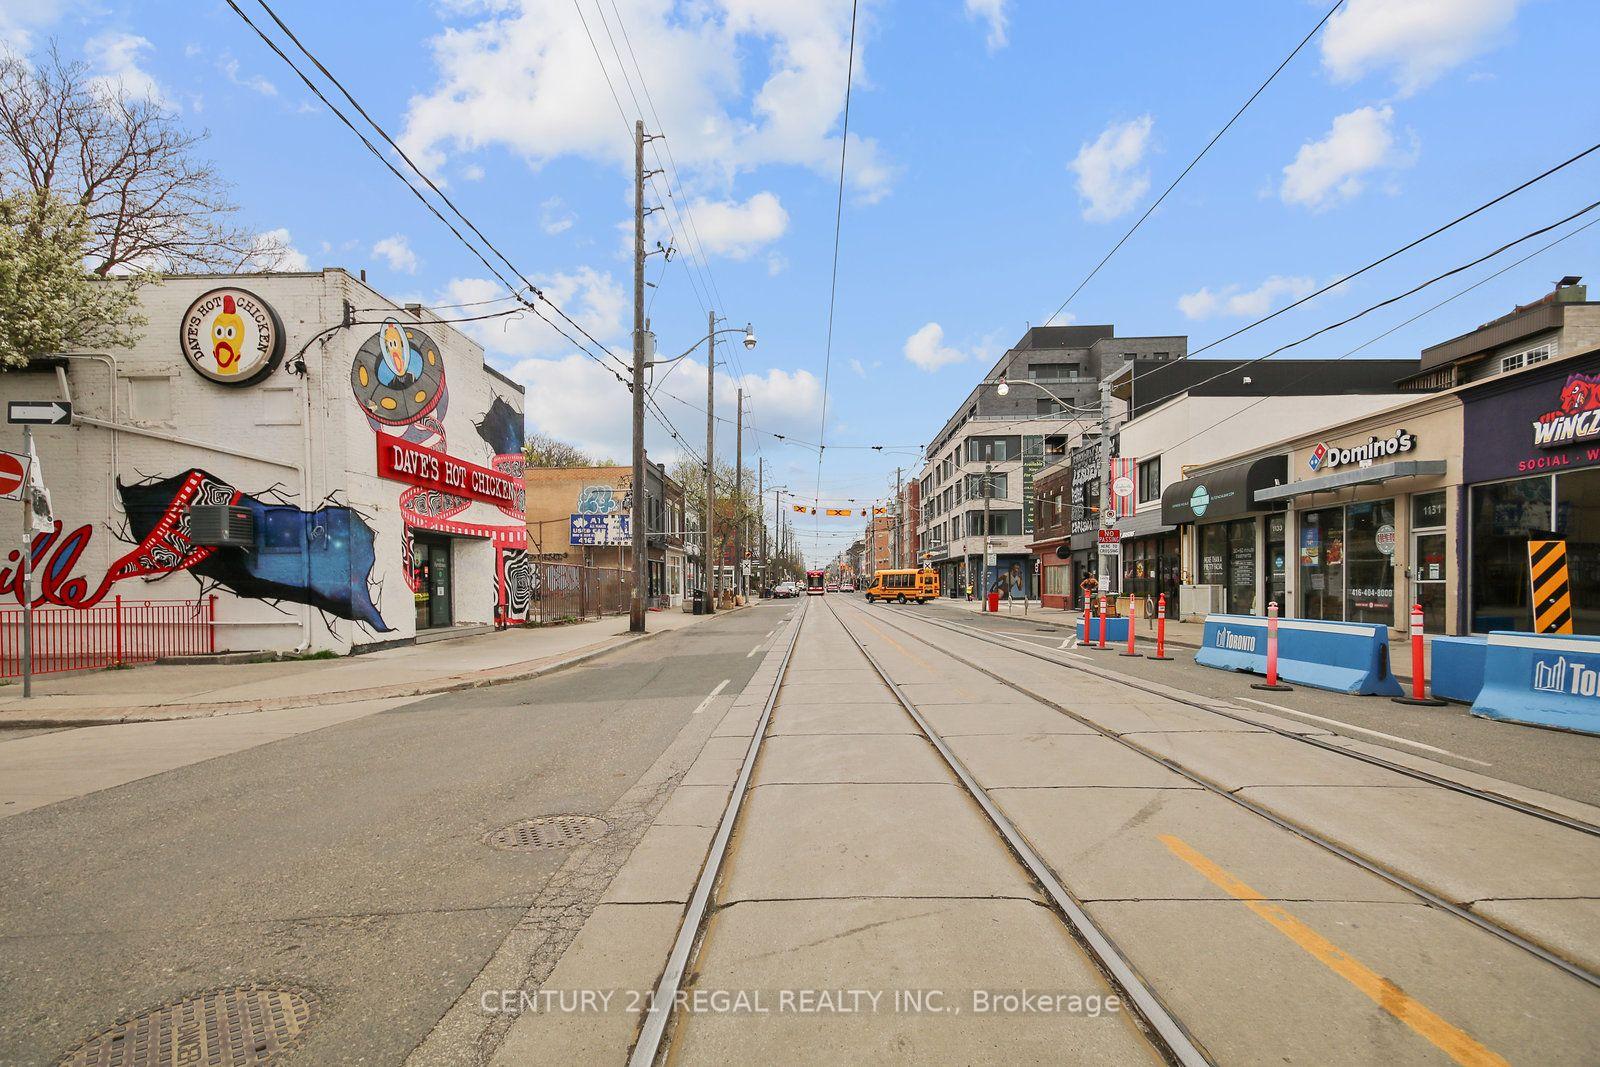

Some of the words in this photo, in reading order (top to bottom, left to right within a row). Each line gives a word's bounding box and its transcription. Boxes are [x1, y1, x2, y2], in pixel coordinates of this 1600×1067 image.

[188, 316, 205, 361] DAVE'S
[197, 296, 222, 317] HOT
[236, 297, 270, 353] CHICKEN
[1327, 429, 1412, 467] Domino's
[1518, 454, 1570, 471] SOCIAL
[392, 445, 439, 481] DAVE'S
[444, 461, 467, 488] HOT
[472, 471, 518, 501] CHICKEN
[1226, 630, 1256, 652] TORONTO
